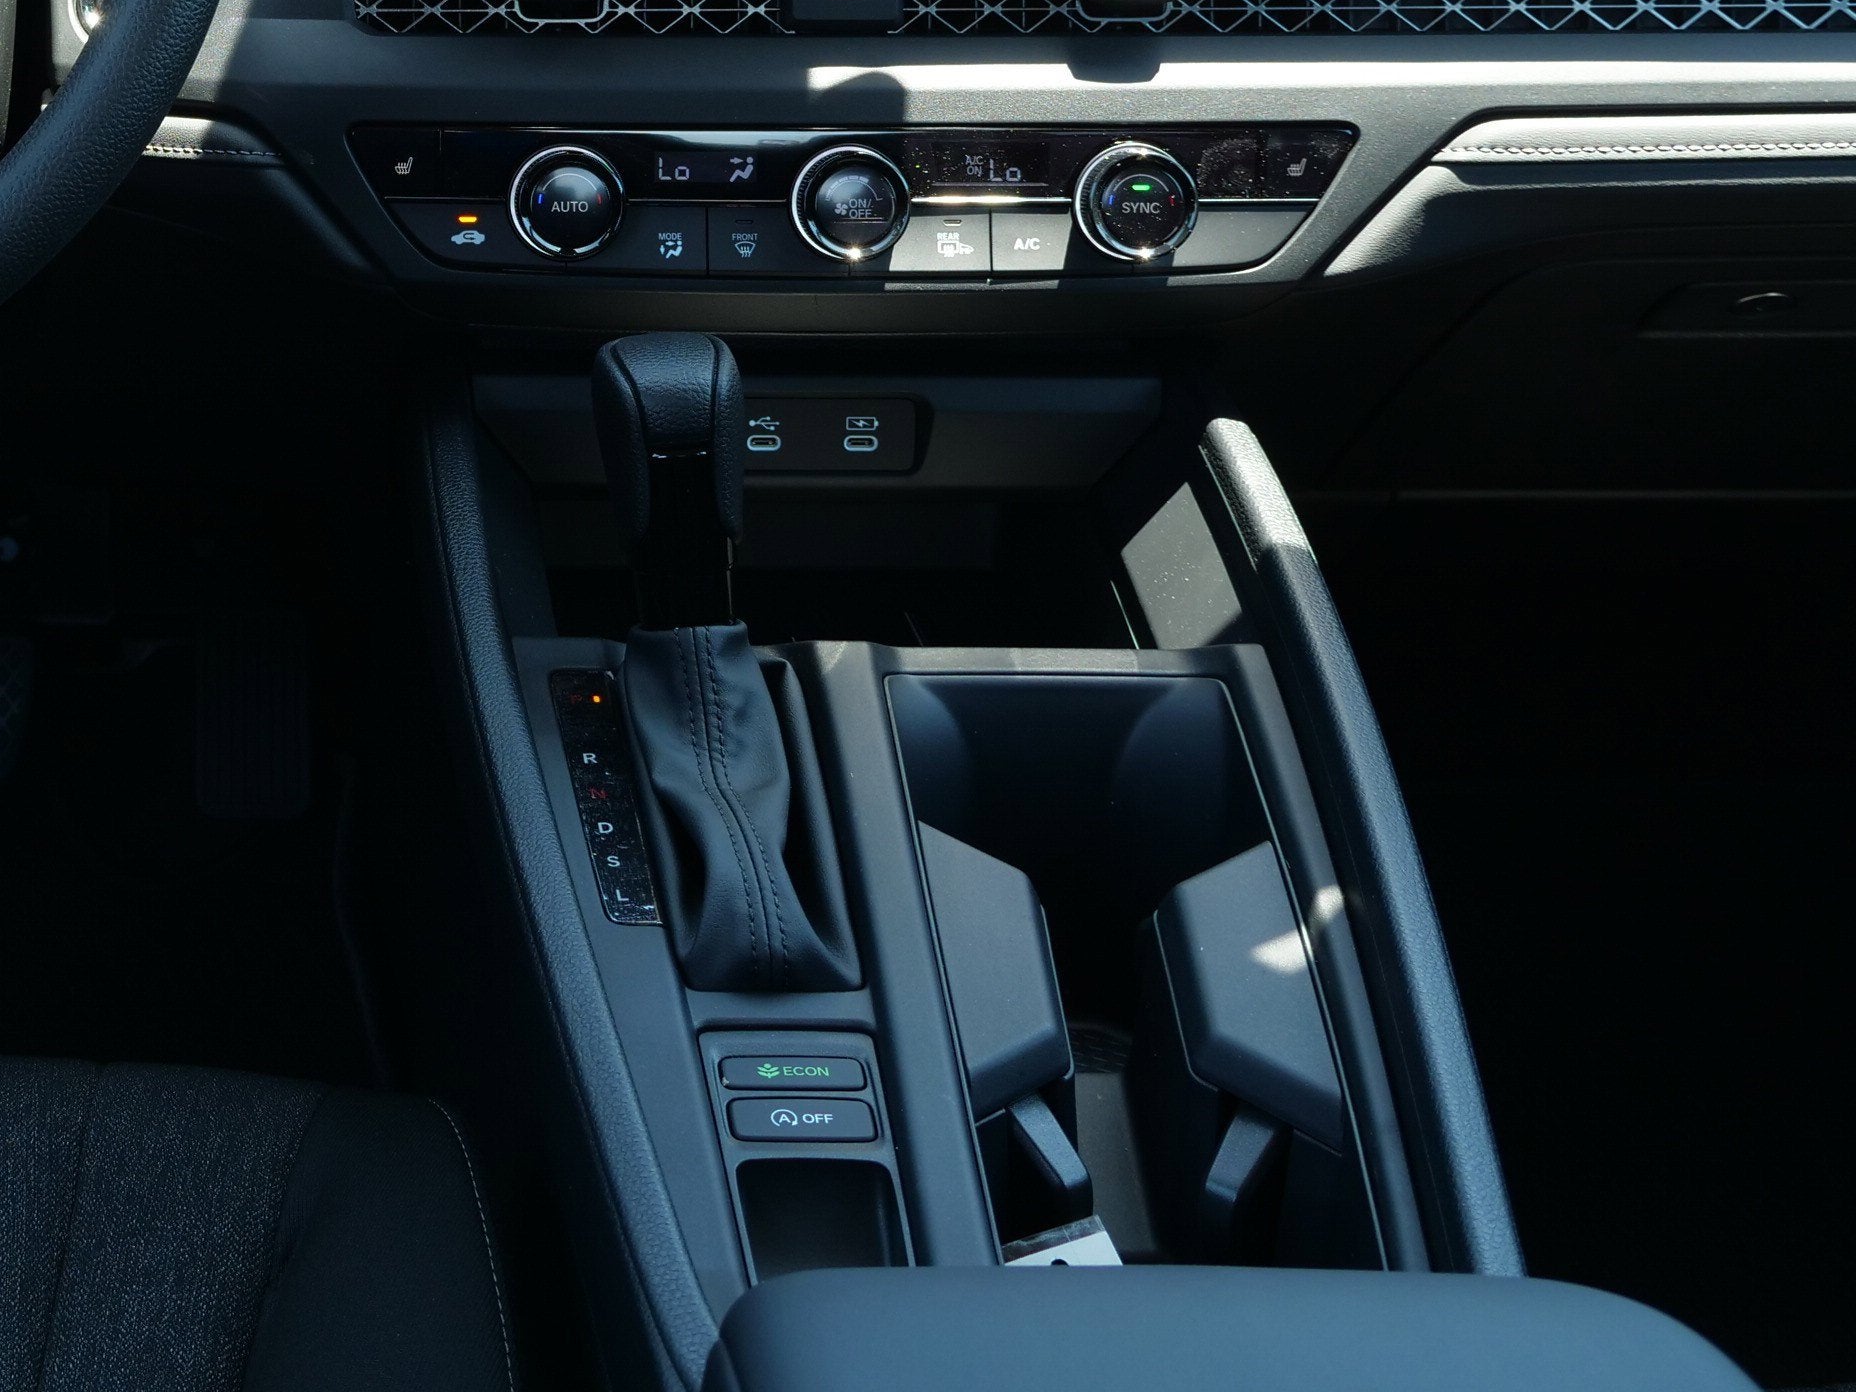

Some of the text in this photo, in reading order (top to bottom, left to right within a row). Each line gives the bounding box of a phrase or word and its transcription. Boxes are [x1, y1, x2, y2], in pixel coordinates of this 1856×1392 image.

[965, 155, 983, 165] A/C
[657, 157, 690, 181] Lo
[967, 166, 982, 175] ON
[989, 158, 1021, 182] Lo
[551, 201, 589, 213] AUTO
[848, 198, 873, 209] ON/
[1121, 202, 1160, 214] SYNC
[849, 209, 872, 219] OFF
[658, 232, 682, 240] MODE
[732, 233, 758, 241] FRONT
[937, 232, 960, 240] REAR
[1013, 237, 1041, 250] A/C
[583, 752, 598, 764] R
[597, 821, 613, 834] D
[606, 855, 621, 868] S
[616, 889, 629, 901] L
[783, 1066, 830, 1077] ECON
[802, 1113, 834, 1124] OFF
